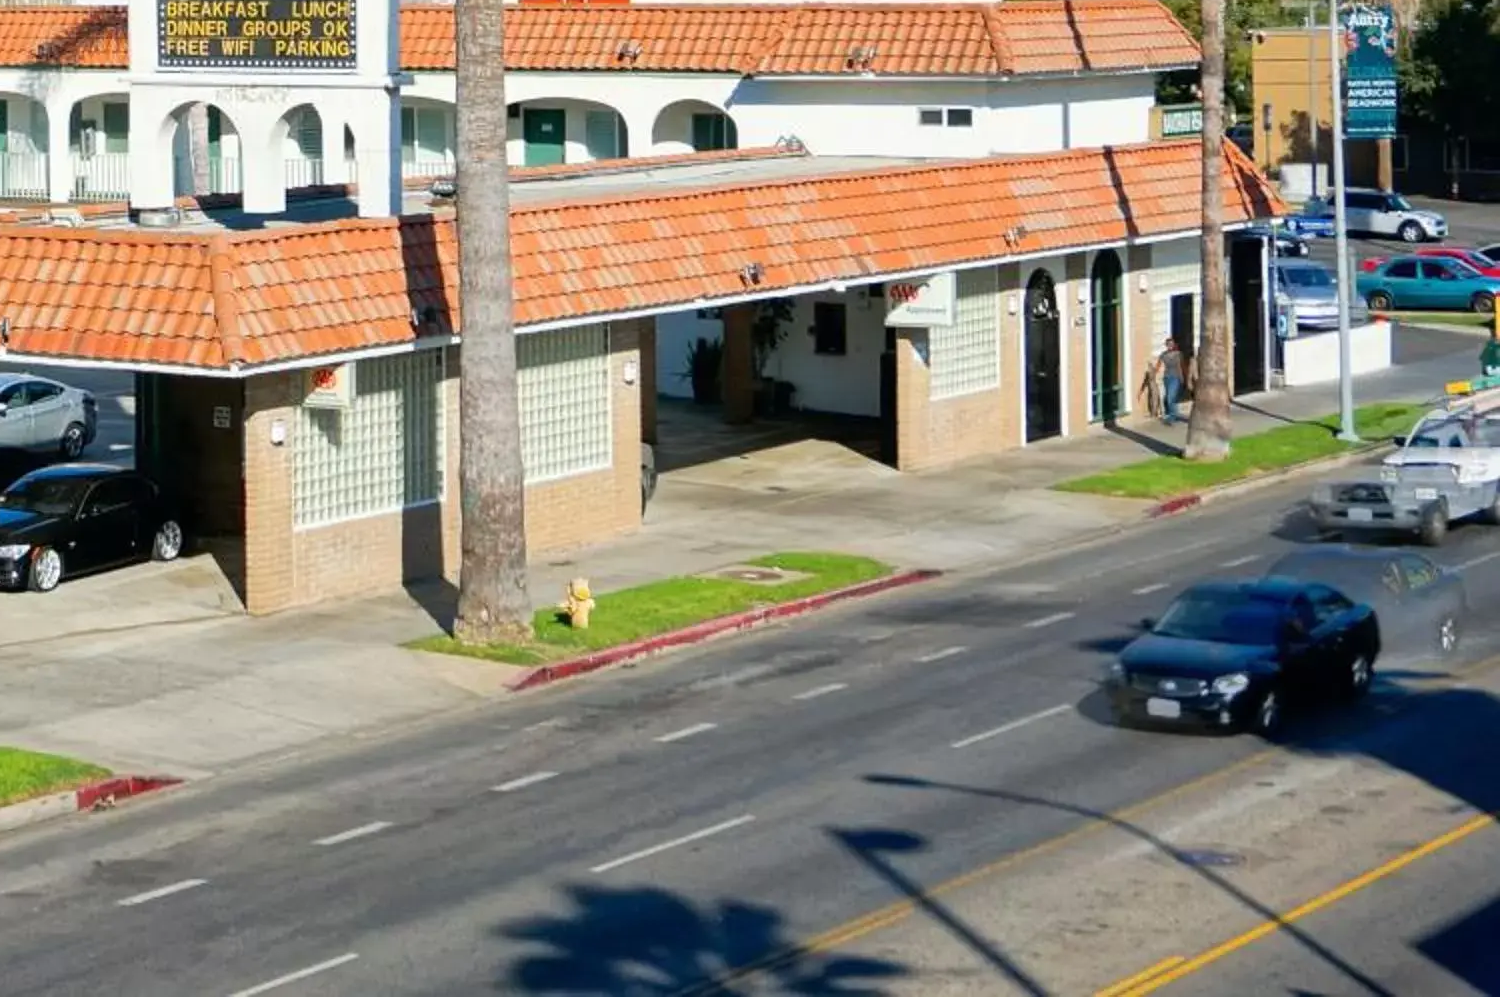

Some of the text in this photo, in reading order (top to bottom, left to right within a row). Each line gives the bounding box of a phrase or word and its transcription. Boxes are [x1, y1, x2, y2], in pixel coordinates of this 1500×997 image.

[166, 0, 350, 18] BREAKFAST LUNCH
[166, 19, 349, 37] DINNER GROUPS OK
[166, 39, 351, 57] FREE WIFI PARKING
